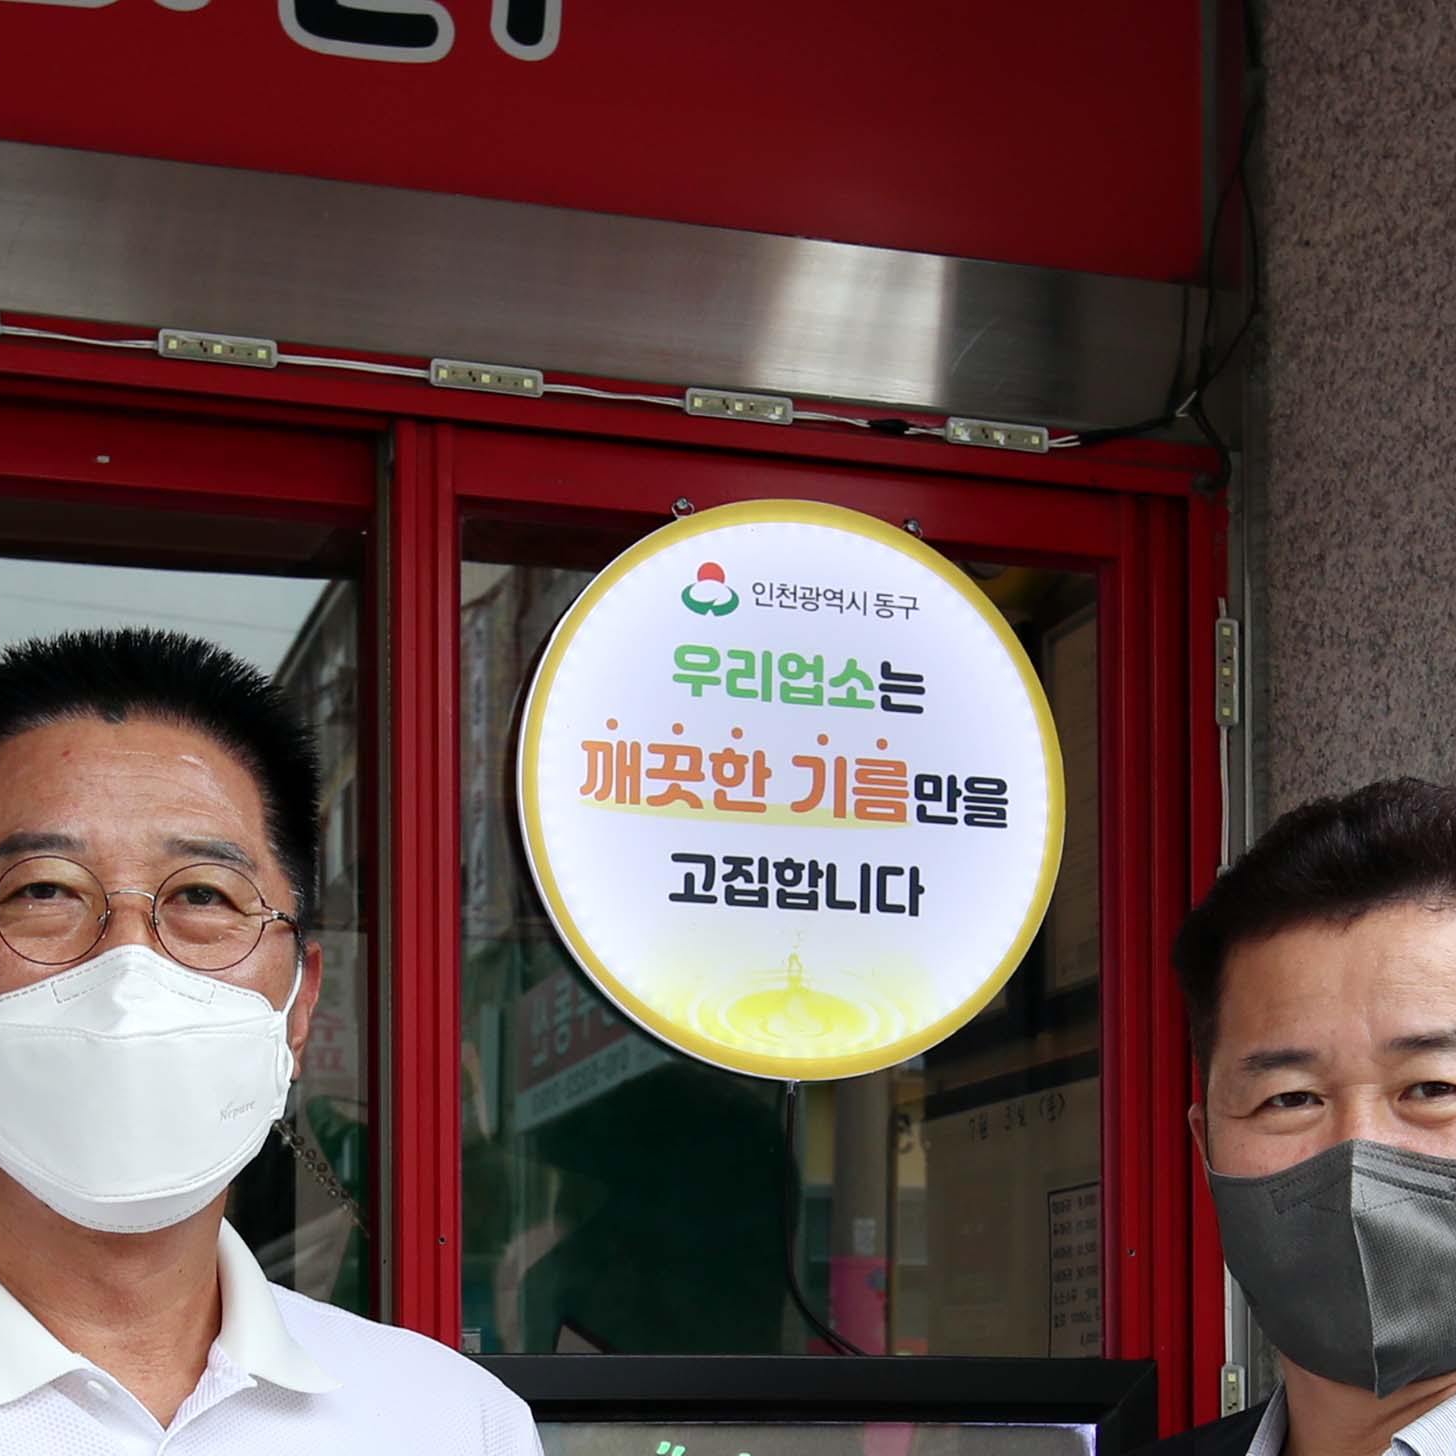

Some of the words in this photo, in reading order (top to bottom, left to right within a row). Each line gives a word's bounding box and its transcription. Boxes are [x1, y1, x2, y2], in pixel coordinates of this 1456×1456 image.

[750, 580, 869, 617] 인천광역시
[872, 590, 921, 621] 동구
[670, 642, 927, 716] 우리업소는
[578, 736, 773, 815] 깨끗한
[789, 750, 1010, 830] 기름만을
[667, 851, 926, 918] 고집합니다
